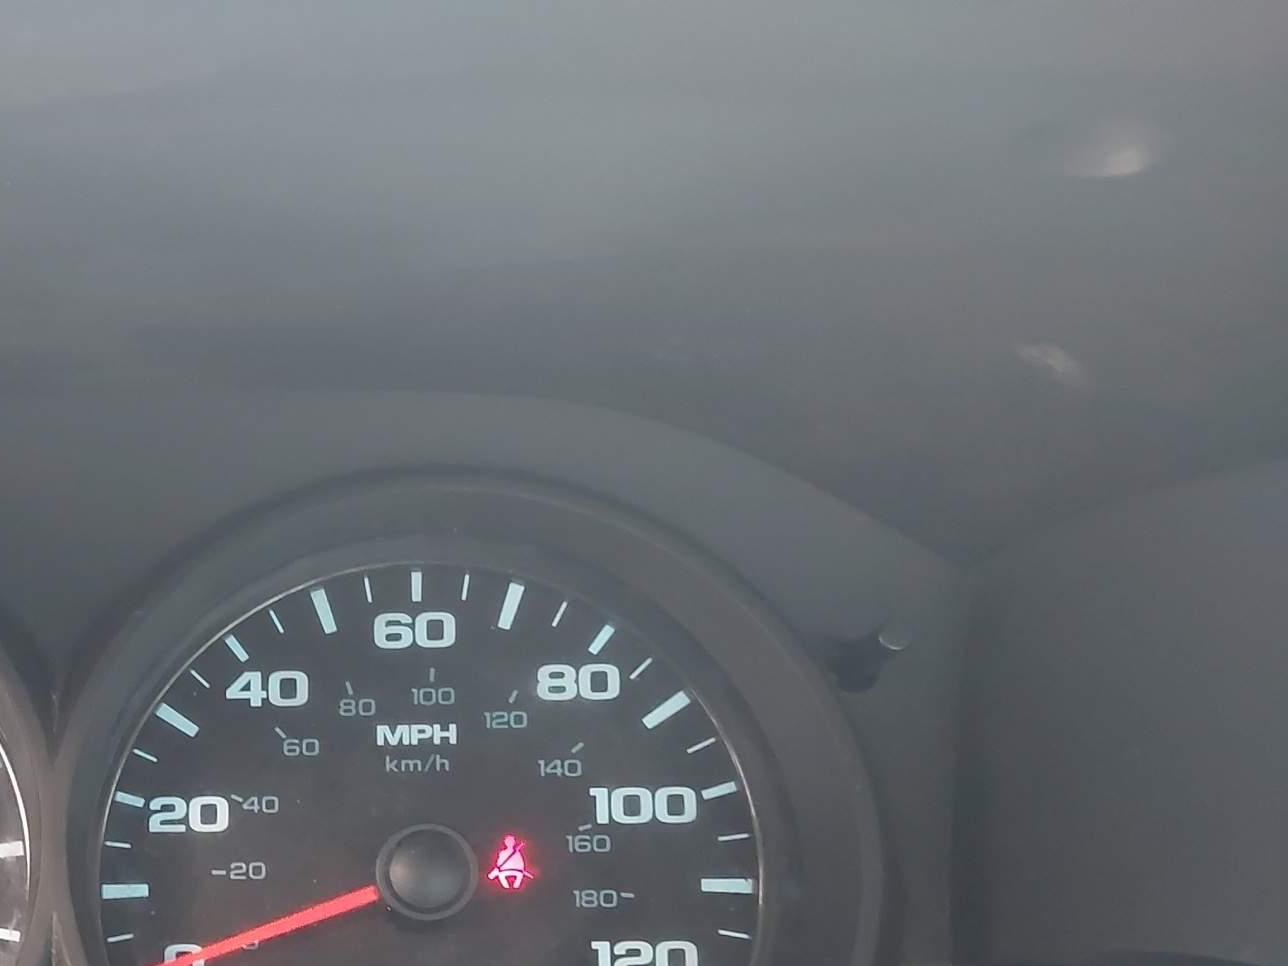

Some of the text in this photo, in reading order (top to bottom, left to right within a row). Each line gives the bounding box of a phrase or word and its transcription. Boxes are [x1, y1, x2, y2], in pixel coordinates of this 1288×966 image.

[373, 612, 456, 649] 60
[225, 670, 308, 707] 40
[536, 664, 621, 701] 80
[411, 687, 455, 706] 100
[338, 697, 376, 716] 80
[484, 711, 527, 729] 120
[376, 724, 457, 746] MPH
[283, 738, 319, 757] 60
[385, 755, 449, 772] km/h
[538, 758, 582, 777] 140
[148, 795, 230, 833] 20
[242, 795, 279, 814] 40
[589, 787, 697, 824] 100
[566, 834, 611, 852] 160
[230, 862, 266, 880] 20
[573, 889, 617, 908] 180
